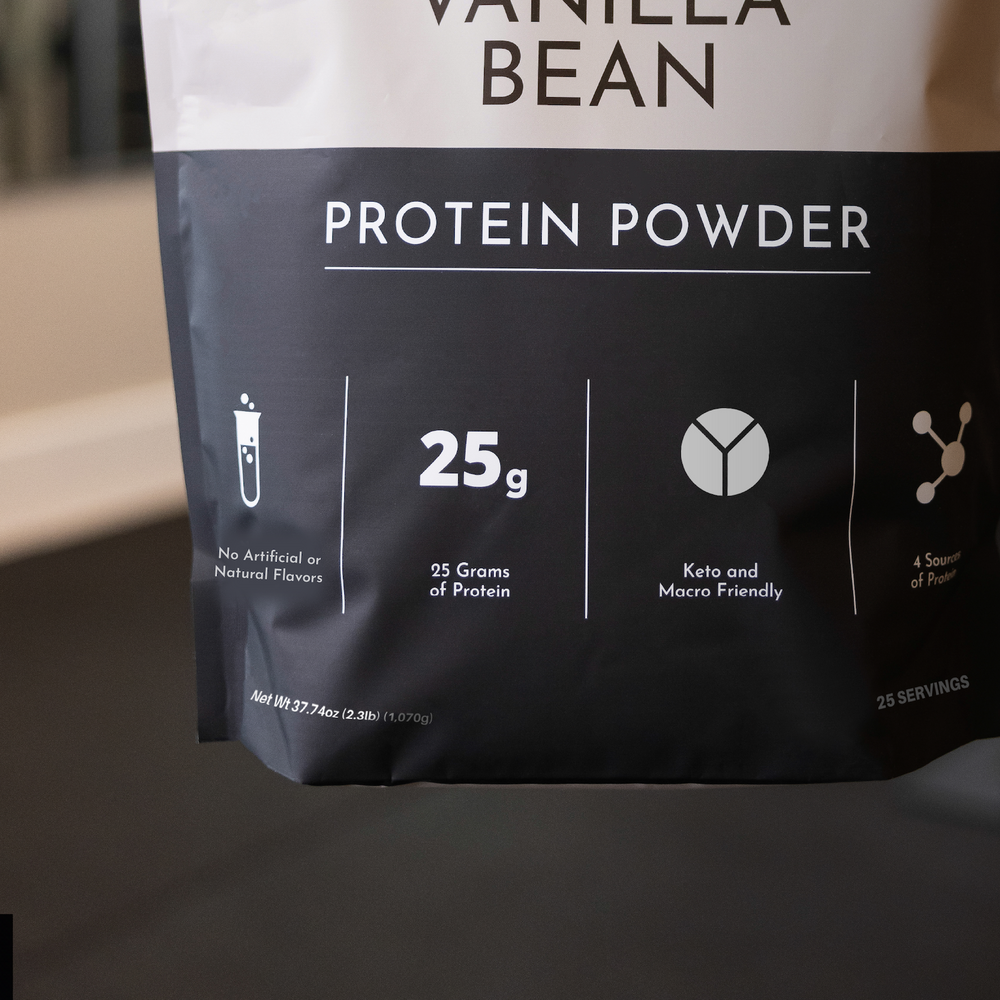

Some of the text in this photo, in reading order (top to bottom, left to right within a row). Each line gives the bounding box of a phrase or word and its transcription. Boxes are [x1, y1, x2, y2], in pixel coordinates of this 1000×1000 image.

[482, 39, 715, 110] BEAN
[324, 201, 871, 249] PROTEIN POWDER
[218, 546, 322, 566] No Artificial or
[913, 554, 921, 569] 4
[214, 565, 323, 583] Natural Flavors
[430, 562, 510, 579] 25 Grams
[683, 562, 758, 579] Keto and
[910, 571, 924, 589] of
[429, 581, 511, 599] of Protein
[658, 582, 783, 601] Macro Friendly
[876, 674, 970, 710] 25 SERVINGS
[250, 689, 433, 726] Net Wt 37.74oz (2.3lb) (1,070g)
